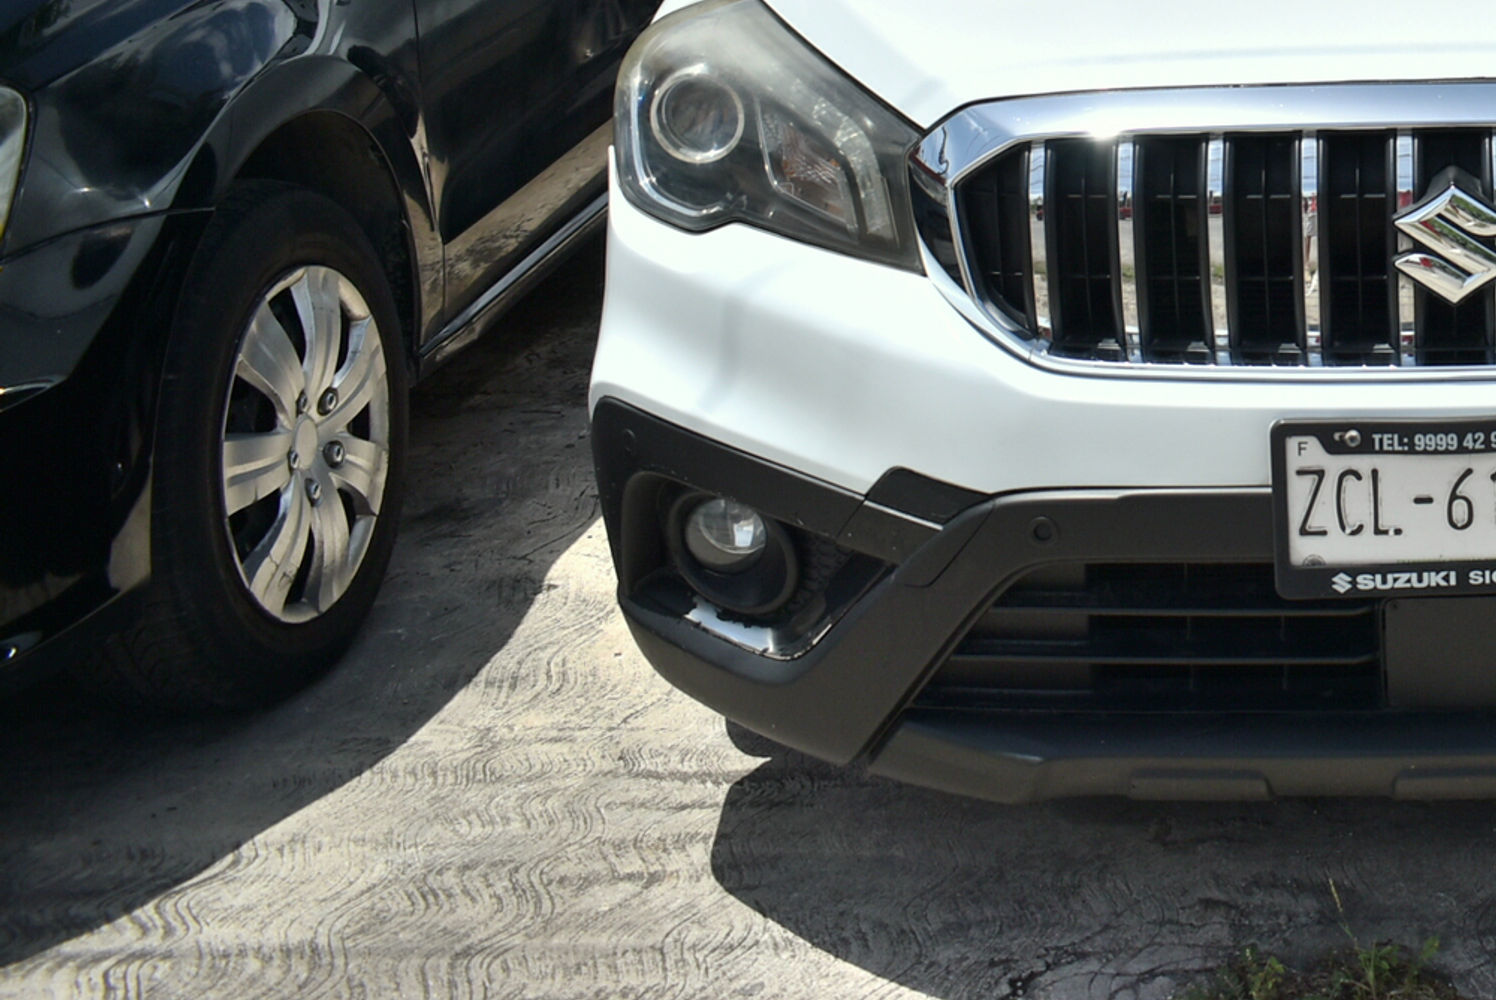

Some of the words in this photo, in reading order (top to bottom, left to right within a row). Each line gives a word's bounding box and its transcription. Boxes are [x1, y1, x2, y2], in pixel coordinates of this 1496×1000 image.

[1372, 433, 1408, 451] TEL:
[1414, 433, 1458, 451] 9999
[1463, 432, 1485, 449] 42
[1355, 570, 1457, 591] SUZUKI
